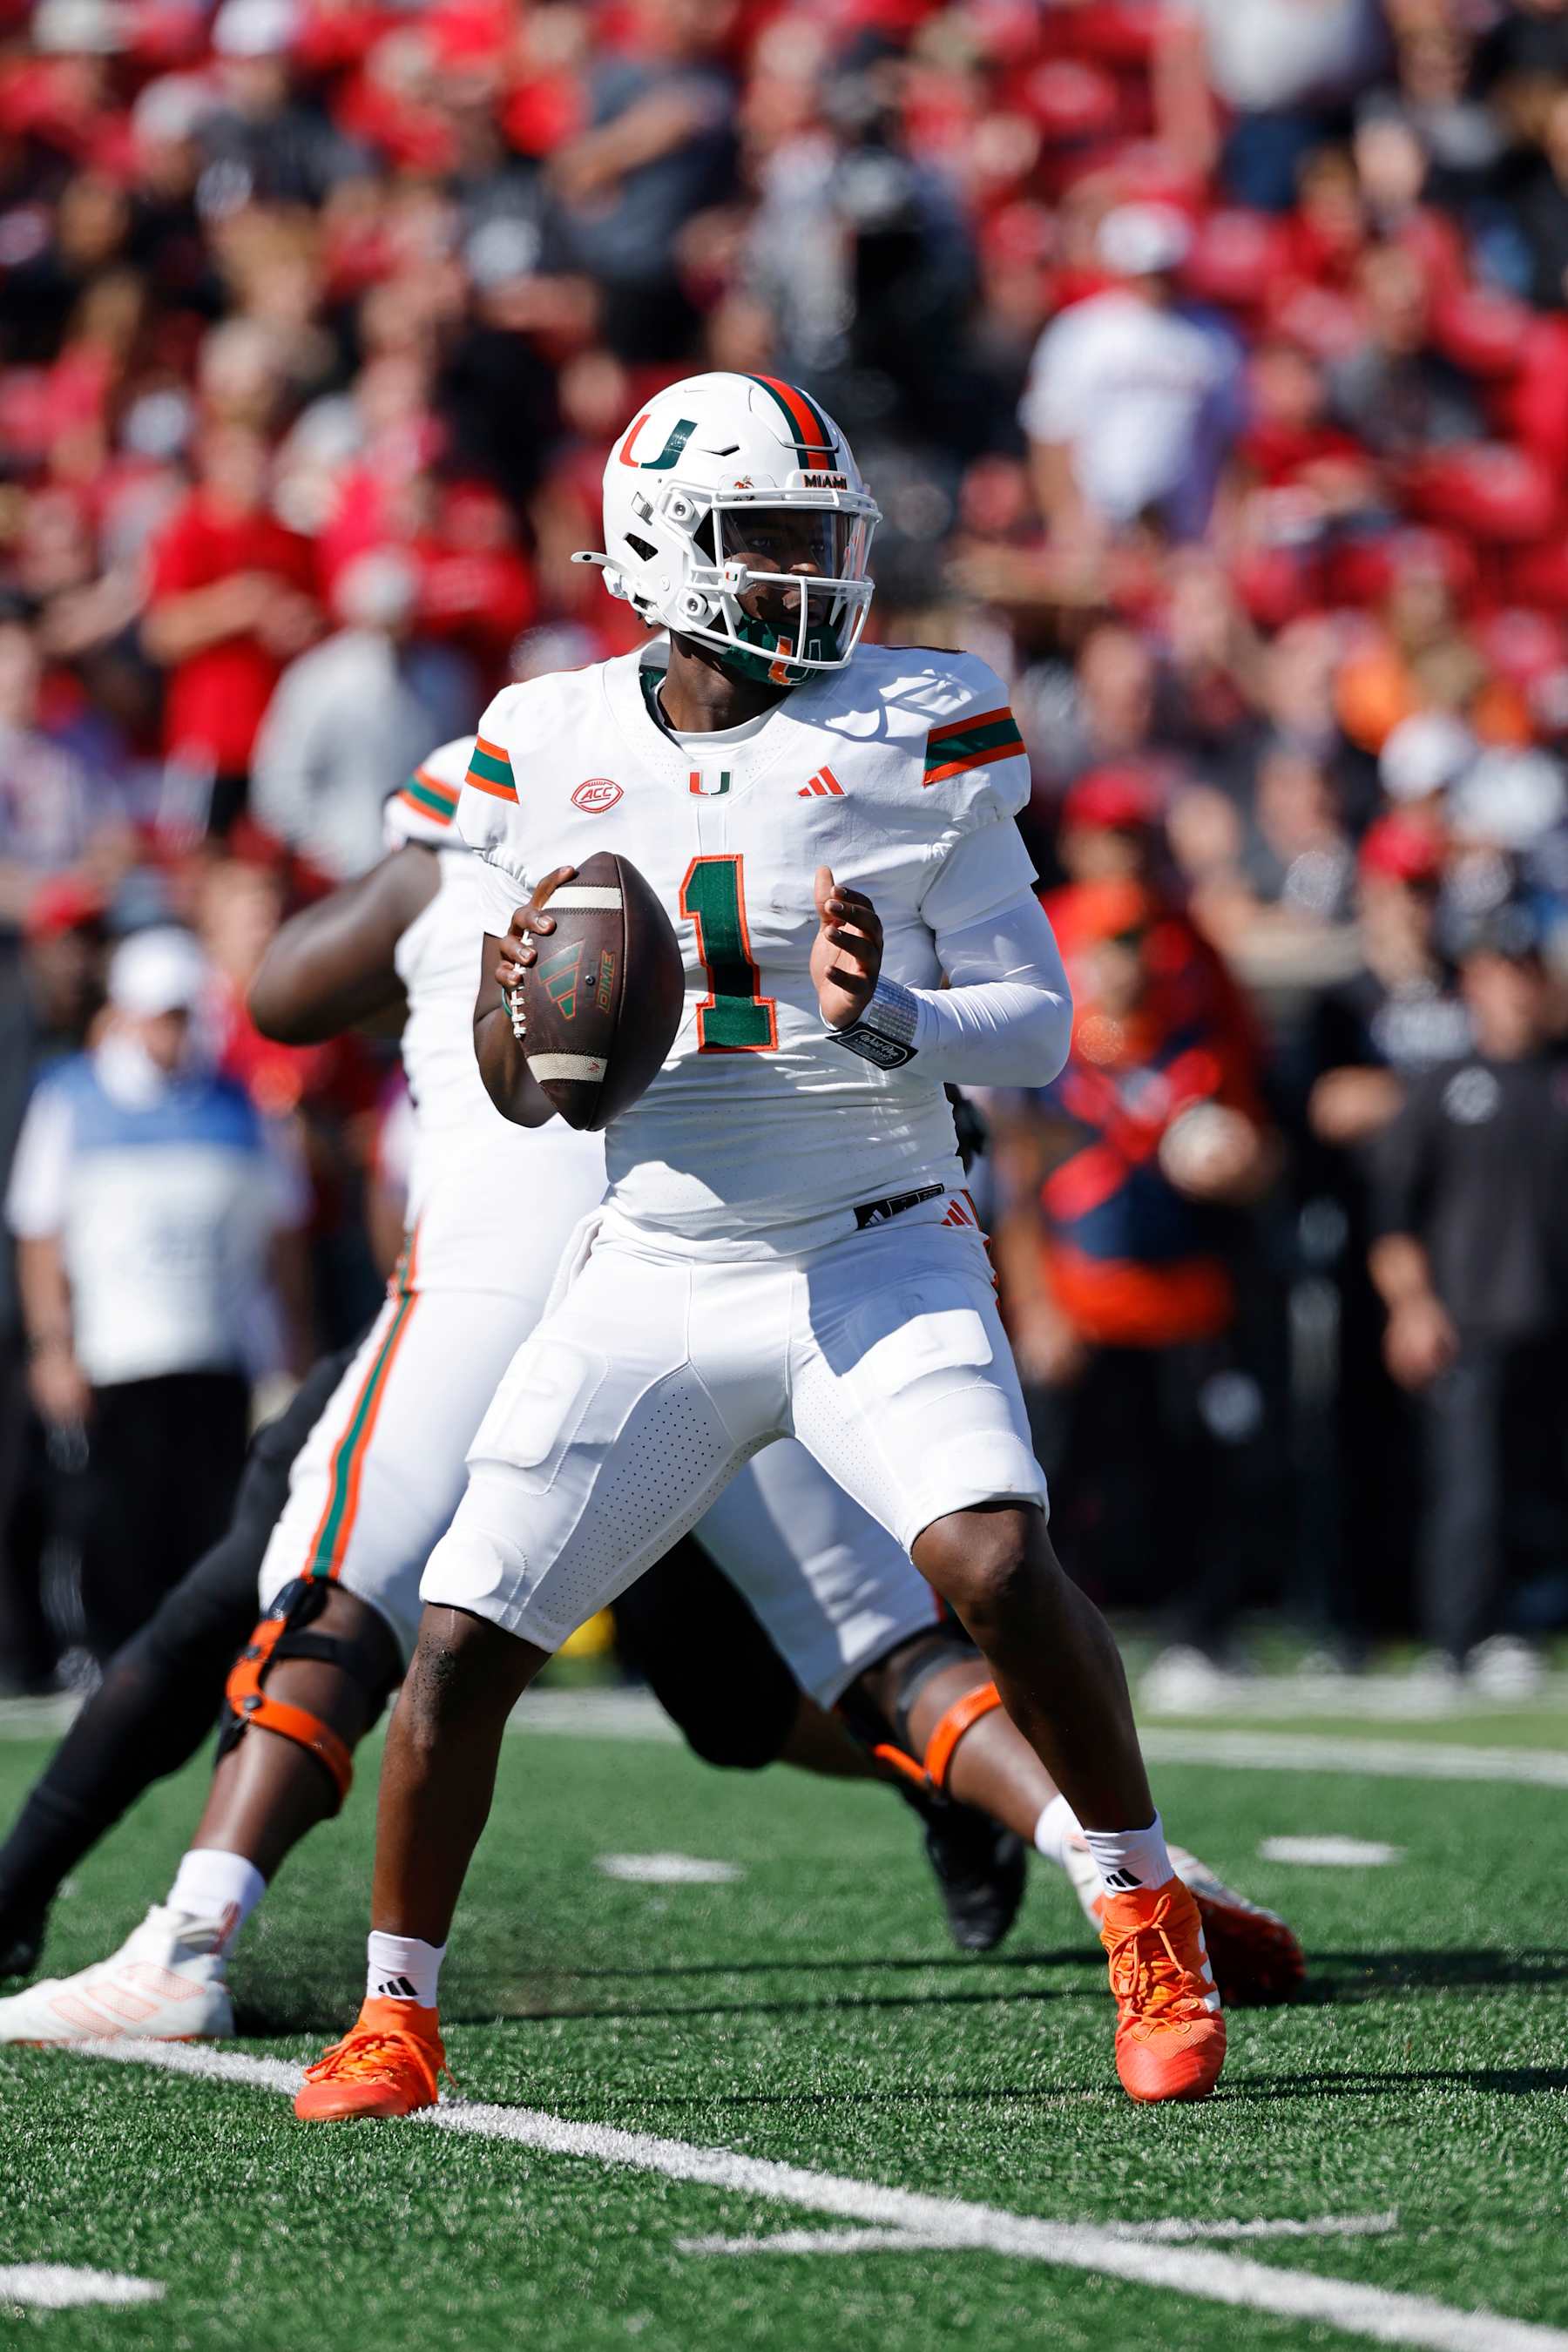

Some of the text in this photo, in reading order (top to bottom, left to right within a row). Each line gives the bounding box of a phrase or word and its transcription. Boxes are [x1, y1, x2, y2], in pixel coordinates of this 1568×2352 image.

[619, 414, 699, 470] U
[802, 474, 848, 490] MIAMI
[580, 786, 613, 801] ACC
[689, 771, 731, 795] U
[679, 854, 779, 1053] 1
[596, 950, 615, 1015] DIME
